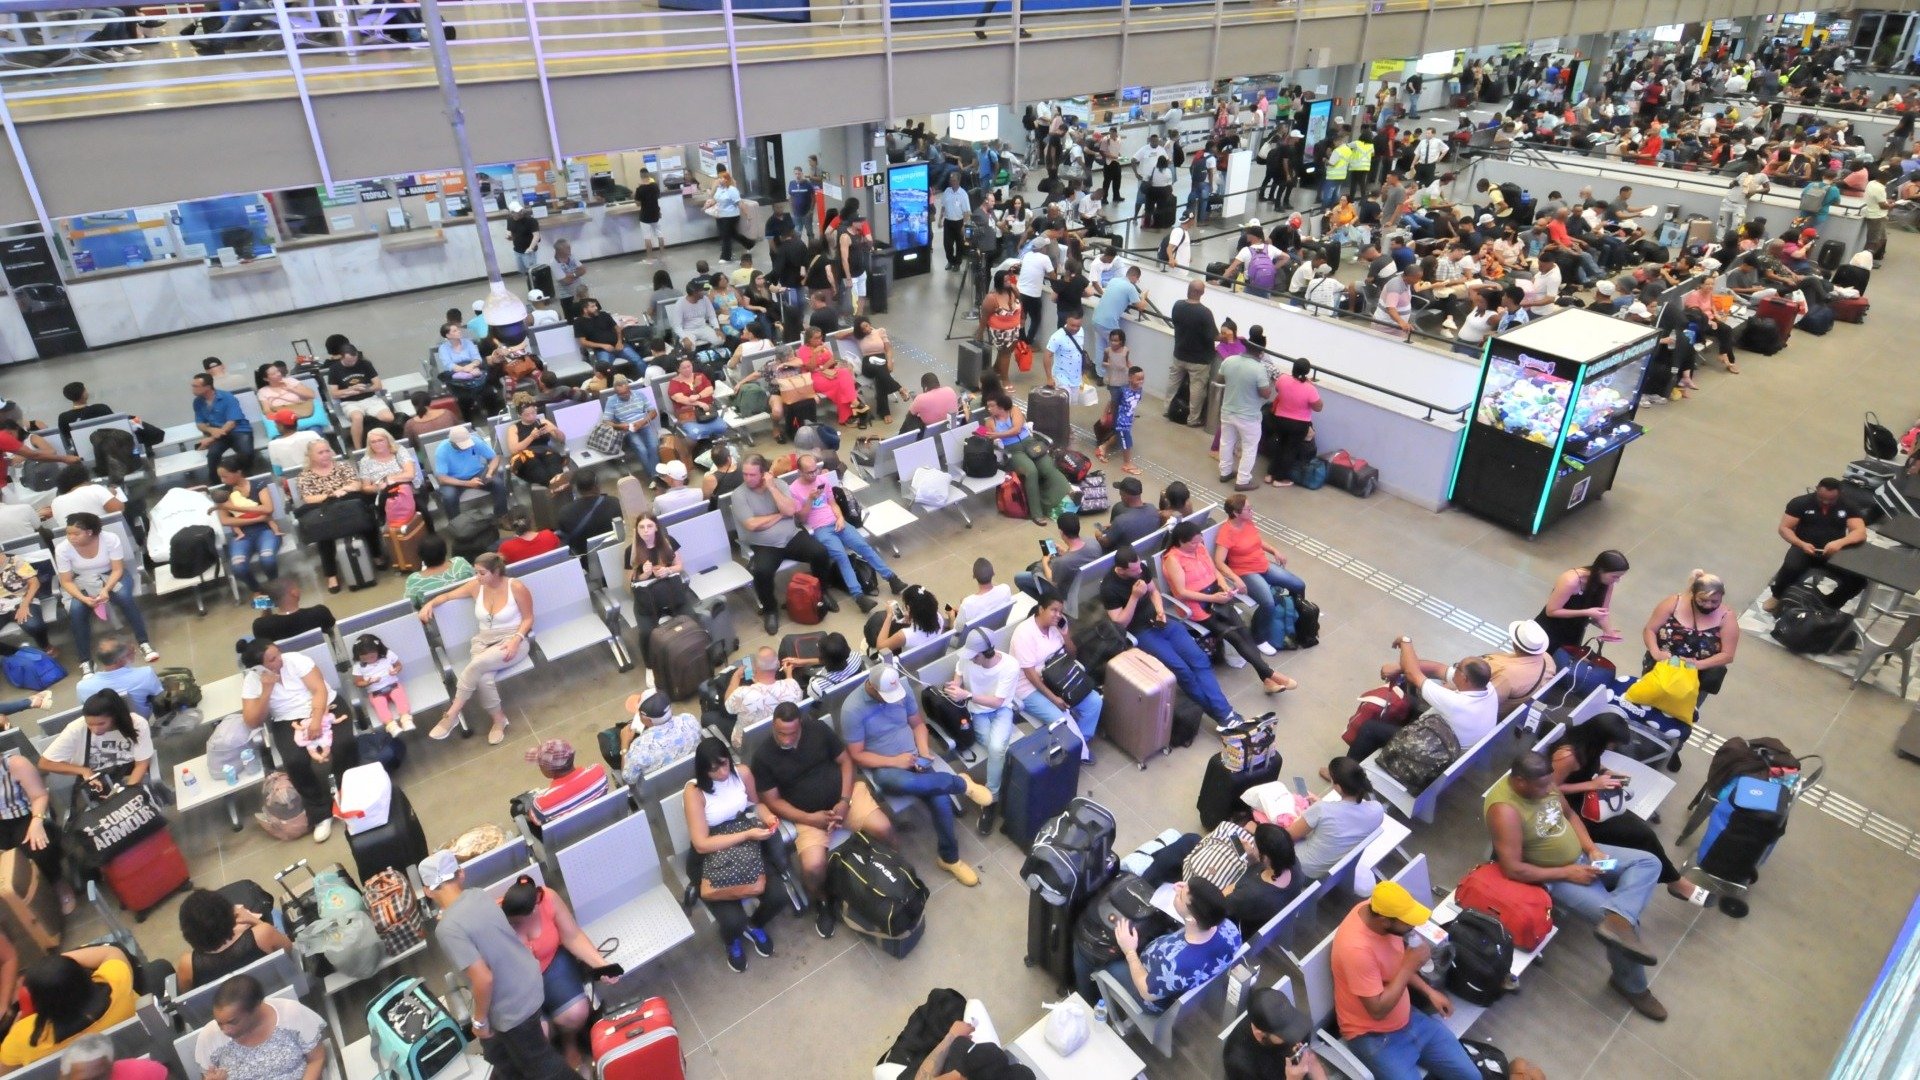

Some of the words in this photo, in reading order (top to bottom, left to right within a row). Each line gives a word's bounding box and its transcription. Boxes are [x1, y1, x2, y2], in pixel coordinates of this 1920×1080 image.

[956, 113, 965, 130] D
[980, 114, 990, 130] D
[106, 794, 144, 825] UNDER
[93, 805, 156, 852] ARMOUR
